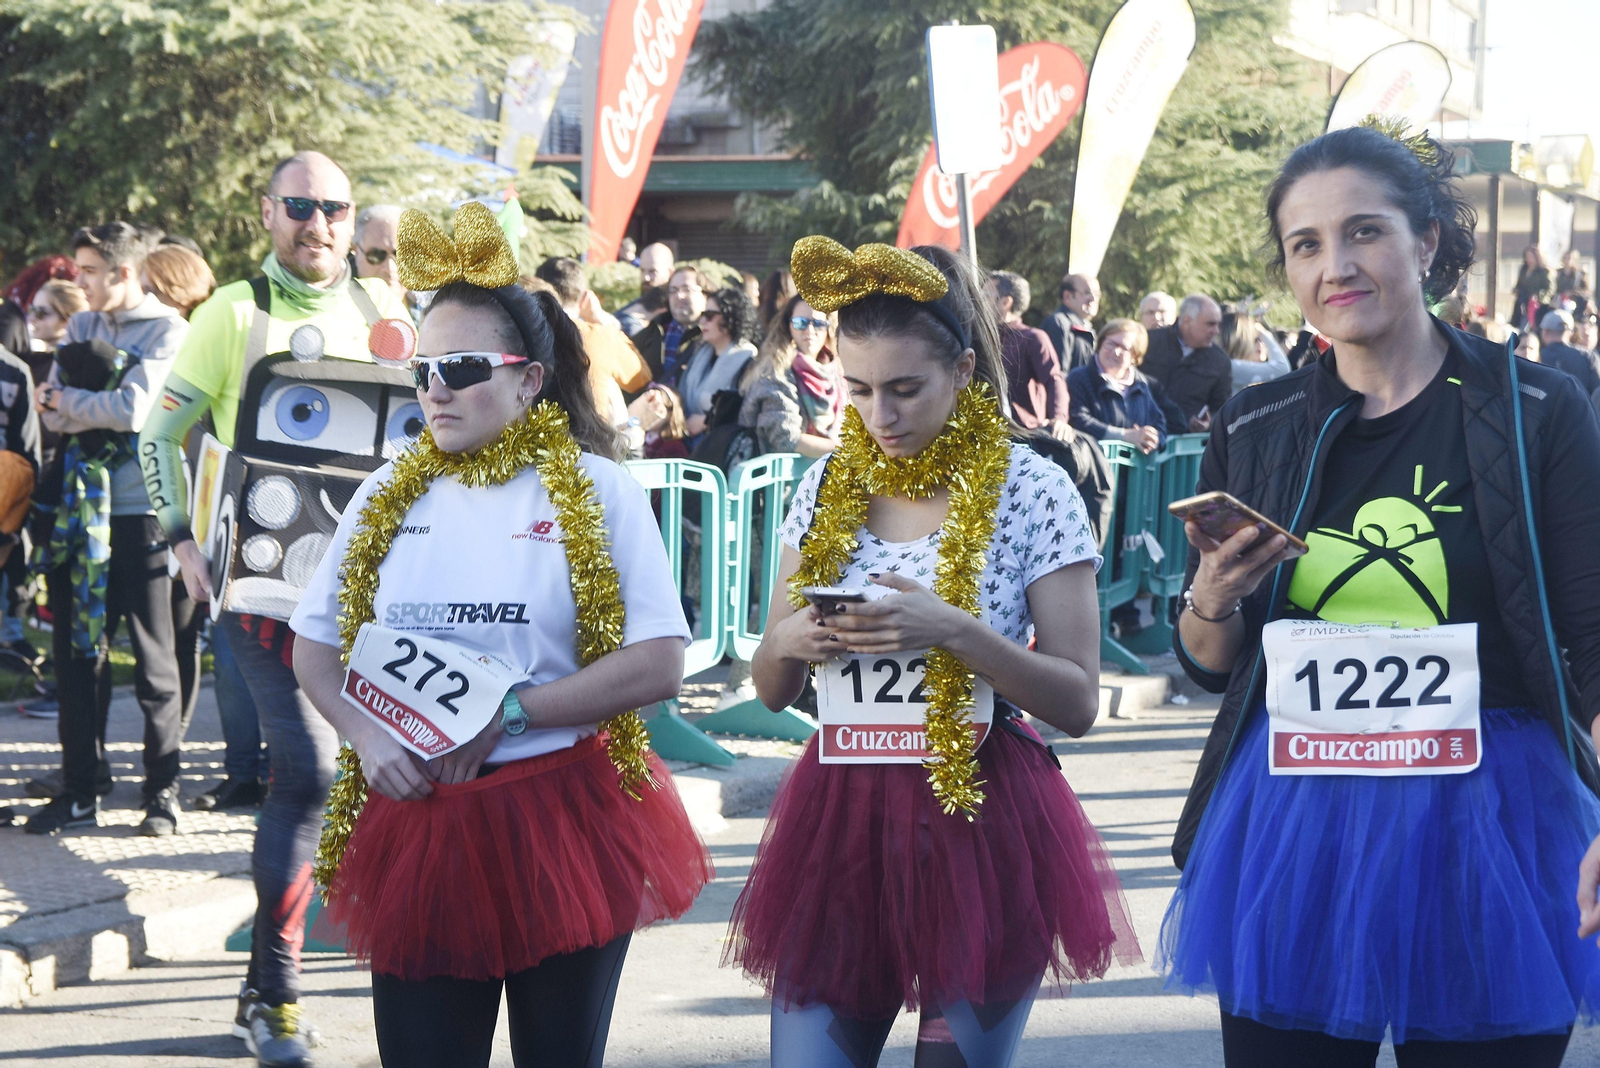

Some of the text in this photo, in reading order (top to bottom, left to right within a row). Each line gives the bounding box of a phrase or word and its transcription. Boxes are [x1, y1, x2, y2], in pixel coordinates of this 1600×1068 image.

[1105, 20, 1162, 114] Cruzcampo
[529, 533, 559, 544] balanc
[382, 638, 470, 716] 272
[841, 658, 930, 703] 122
[1295, 655, 1451, 712] 1222
[355, 678, 440, 748] Cruzcampo
[1288, 734, 1440, 765] Cruzcampo
[1450, 737, 1464, 760] SIN
